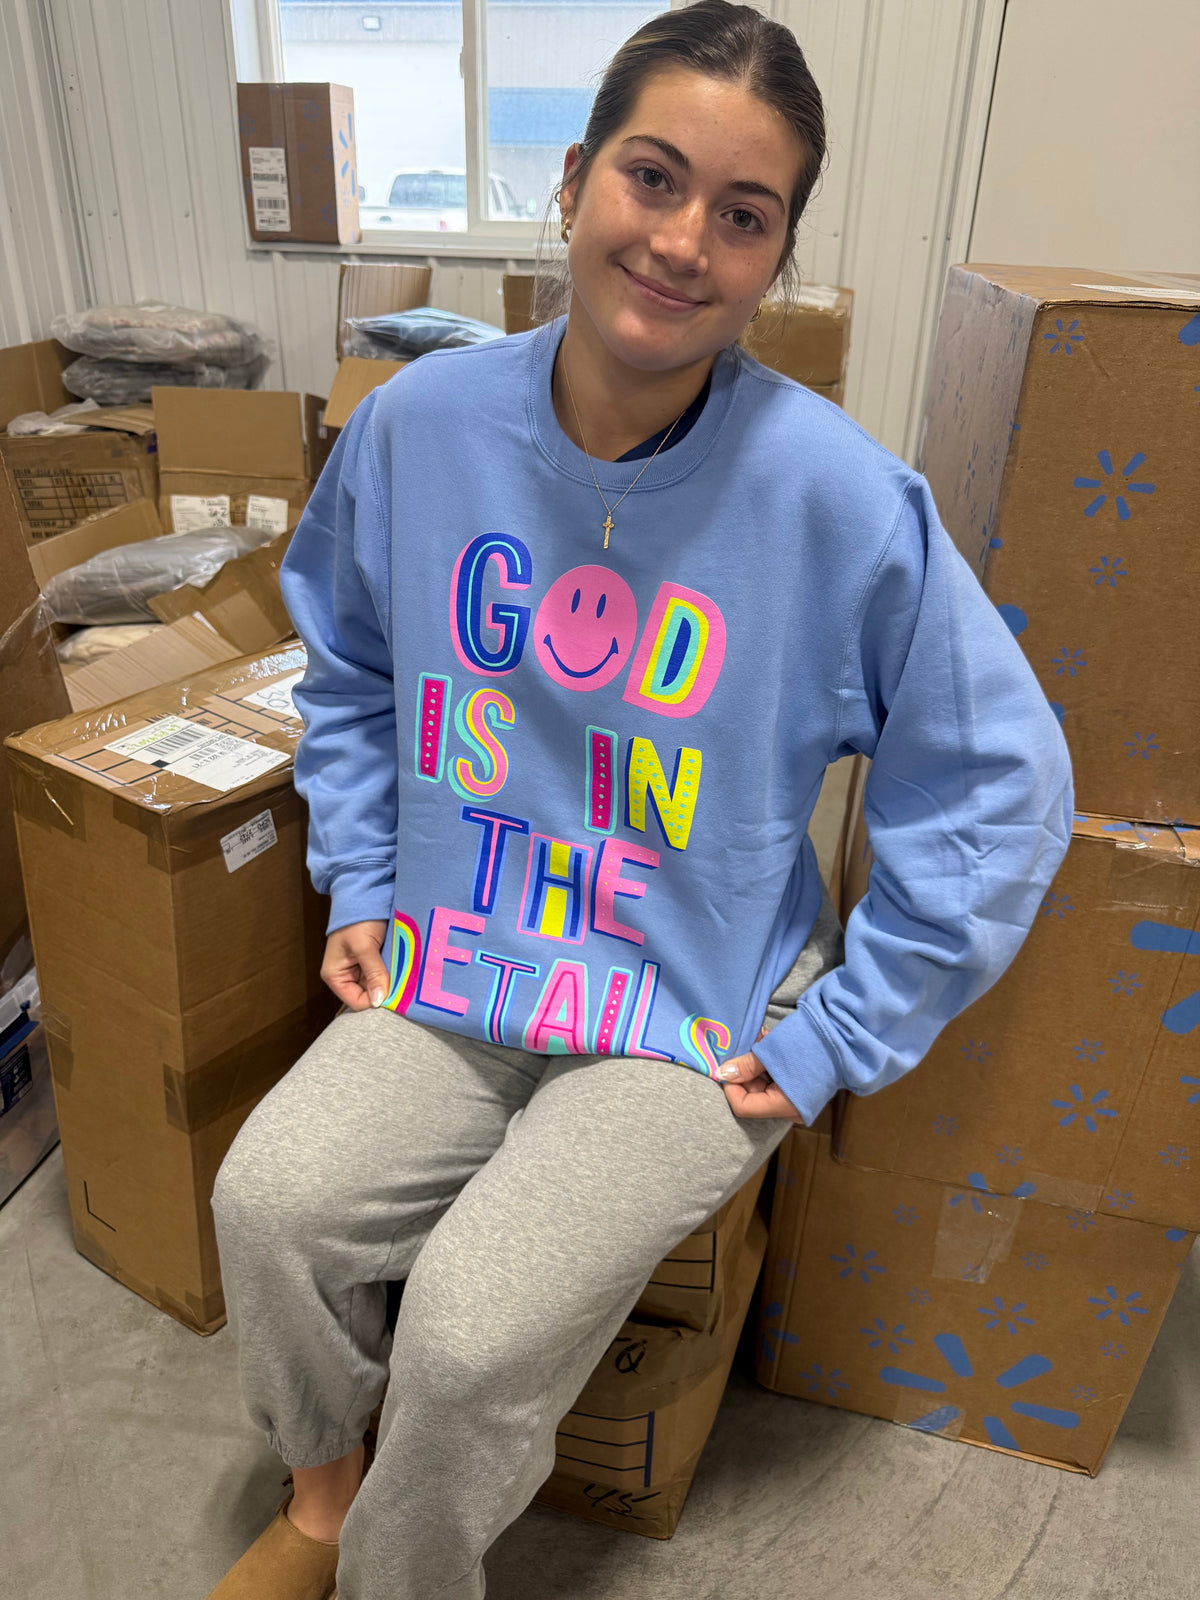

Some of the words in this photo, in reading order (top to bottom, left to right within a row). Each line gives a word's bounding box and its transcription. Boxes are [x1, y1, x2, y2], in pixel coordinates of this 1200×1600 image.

[449, 532, 727, 719] GOD
[415, 672, 518, 803] IS
[585, 725, 702, 851] IN
[459, 804, 660, 946] THE
